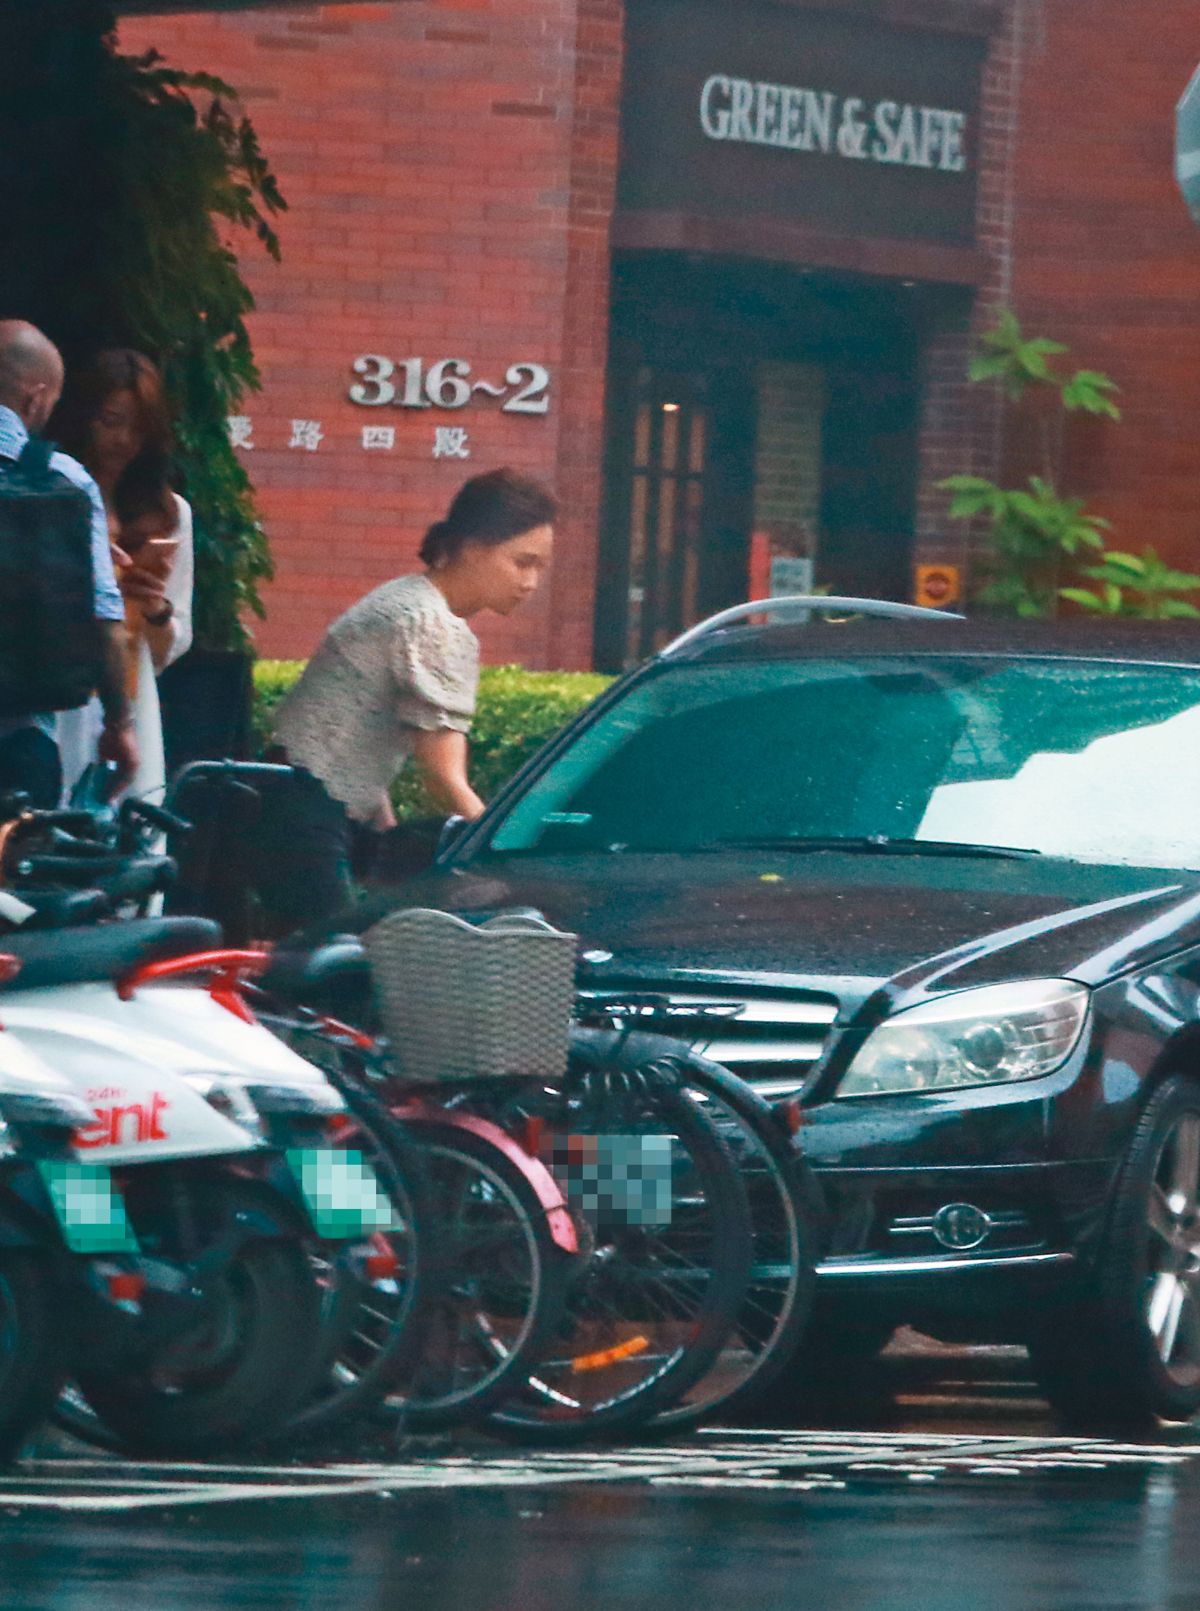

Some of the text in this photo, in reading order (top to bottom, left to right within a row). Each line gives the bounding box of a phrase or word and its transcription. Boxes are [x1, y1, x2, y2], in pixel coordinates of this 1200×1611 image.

[700, 73, 966, 172] GREEN & SAFE
